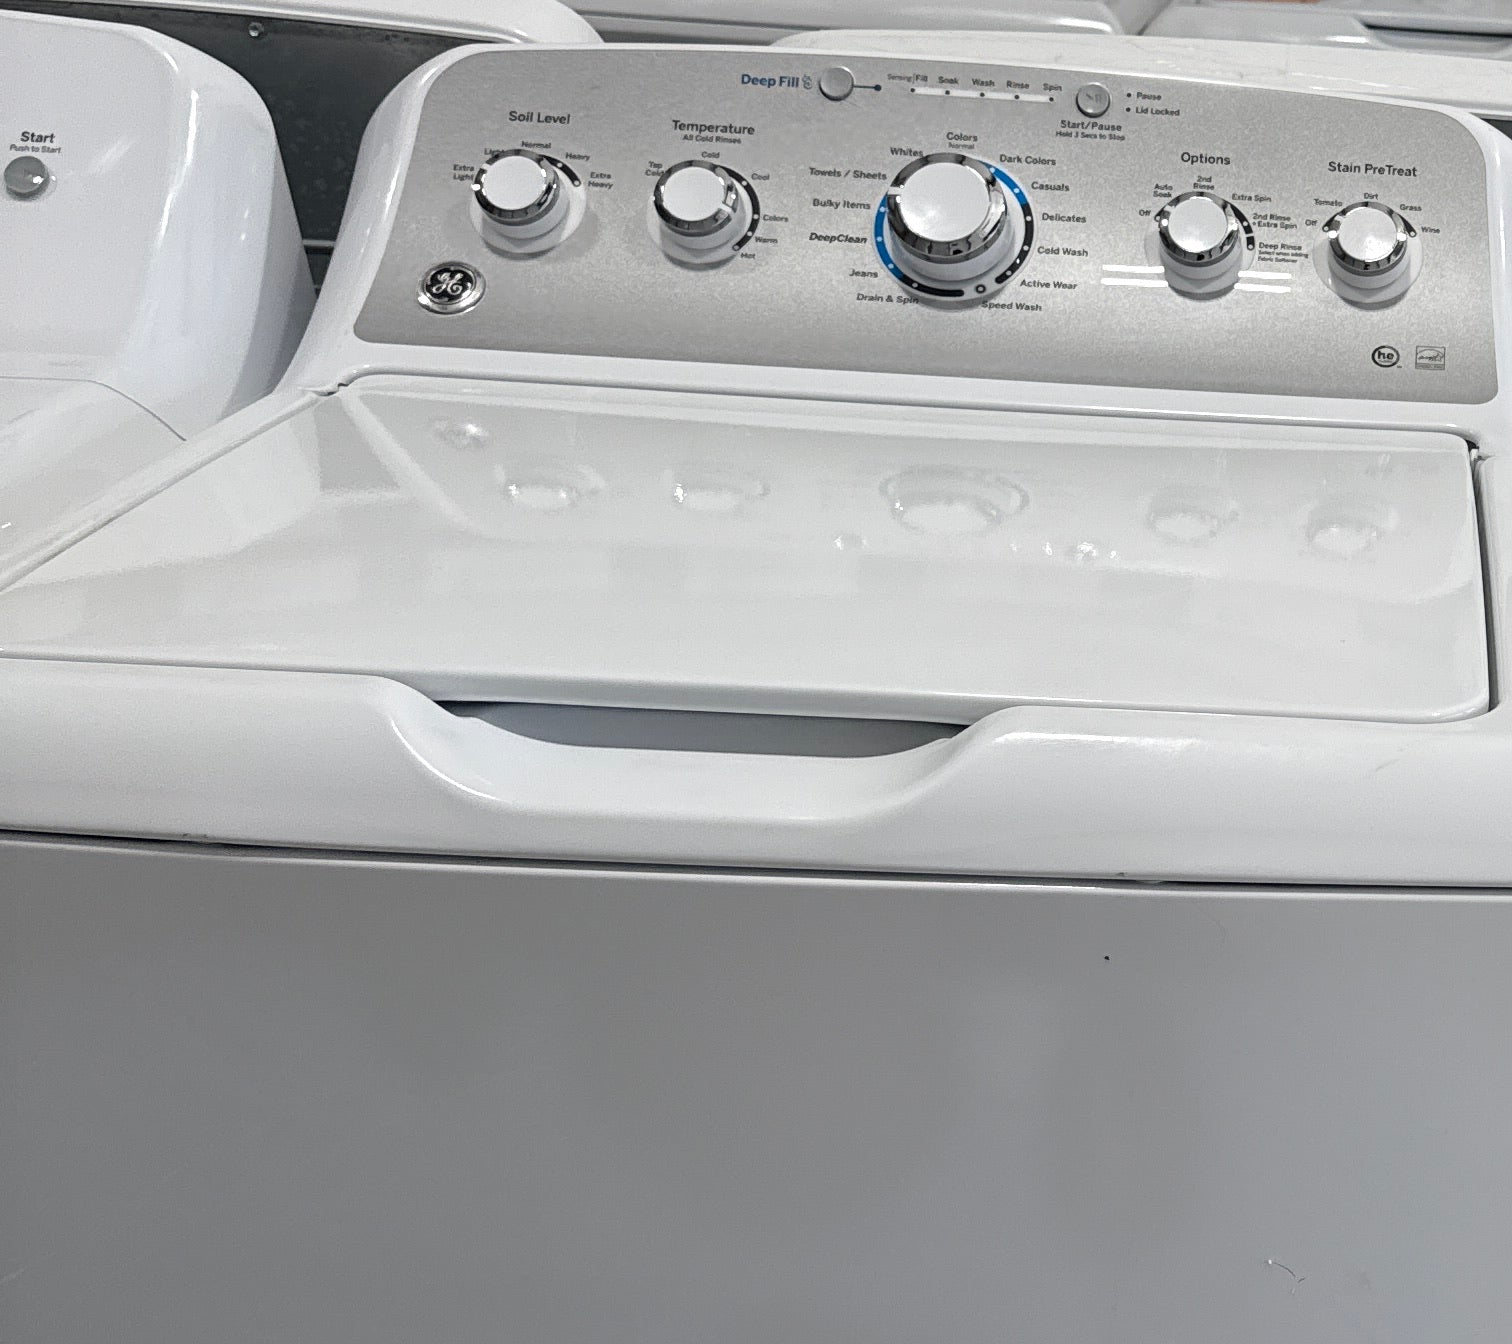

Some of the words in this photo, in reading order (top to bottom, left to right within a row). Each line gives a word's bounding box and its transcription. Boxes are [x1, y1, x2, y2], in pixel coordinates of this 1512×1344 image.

[741, 74, 776, 88] Deep
[779, 76, 799, 88] Fill
[938, 76, 958, 84] Soak
[972, 78, 994, 87] Wash
[1006, 80, 1029, 89] Rinse
[1043, 83, 1062, 92] Spin
[1136, 92, 1161, 101] Pause
[1150, 108, 1180, 116] Locked
[509, 110, 533, 123] Soil
[537, 112, 570, 125] Level
[672, 120, 755, 135] Temperature
[1061, 120, 1122, 132] Start/Pause
[20, 131, 55, 143] Start
[946, 132, 978, 142] Colors
[890, 147, 923, 157] Whites
[1000, 154, 1022, 164] Dark
[1025, 156, 1056, 166] Colors
[1180, 152, 1230, 166] Options
[809, 167, 842, 178] Towels
[853, 170, 887, 180] Sheets
[1328, 161, 1361, 174] Stain
[1365, 163, 1417, 177] PreTreat
[1031, 182, 1070, 192] Casuals
[1232, 193, 1252, 201] Extra
[1254, 194, 1271, 203] Spin
[1364, 192, 1378, 200] Dirt
[813, 199, 840, 209] Bulky
[843, 200, 870, 209] Items
[1314, 198, 1342, 207] Tomato
[1042, 213, 1086, 223] Delicates
[1258, 221, 1278, 229] Extra
[1280, 222, 1297, 230] Spin
[1421, 226, 1440, 234] Wine
[809, 232, 867, 244] DeepClean
[1038, 246, 1062, 255] Cold
[1065, 247, 1088, 257] Wash
[1259, 242, 1277, 251] Deep
[1280, 243, 1302, 251] Rinse
[849, 269, 878, 278] Jeans
[1020, 280, 1050, 289] Active
[1053, 281, 1077, 289] Wear
[857, 293, 883, 303] Drain
[886, 295, 893, 303] &
[897, 295, 918, 305] Spin
[981, 301, 1012, 311] Speed
[1015, 302, 1042, 311] Wash
[1377, 350, 1394, 360] he
